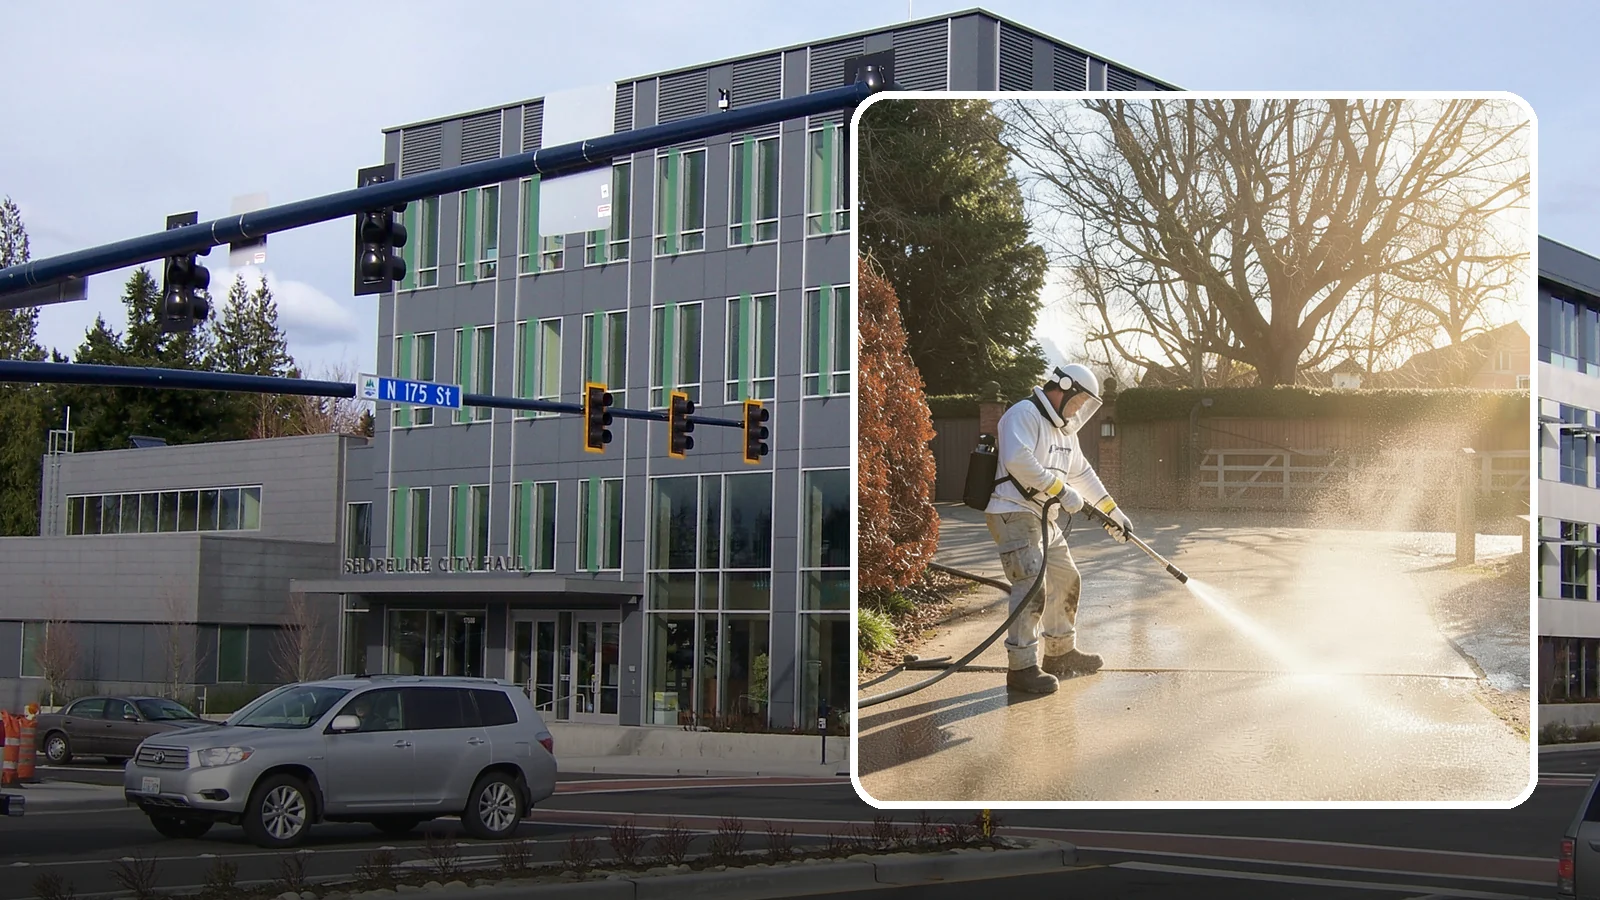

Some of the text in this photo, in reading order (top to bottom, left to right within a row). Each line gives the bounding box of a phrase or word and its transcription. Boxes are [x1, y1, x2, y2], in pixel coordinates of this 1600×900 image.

[387, 380, 451, 406] N 175 St
[344, 556, 525, 574] SHORELINE CITY HALL
